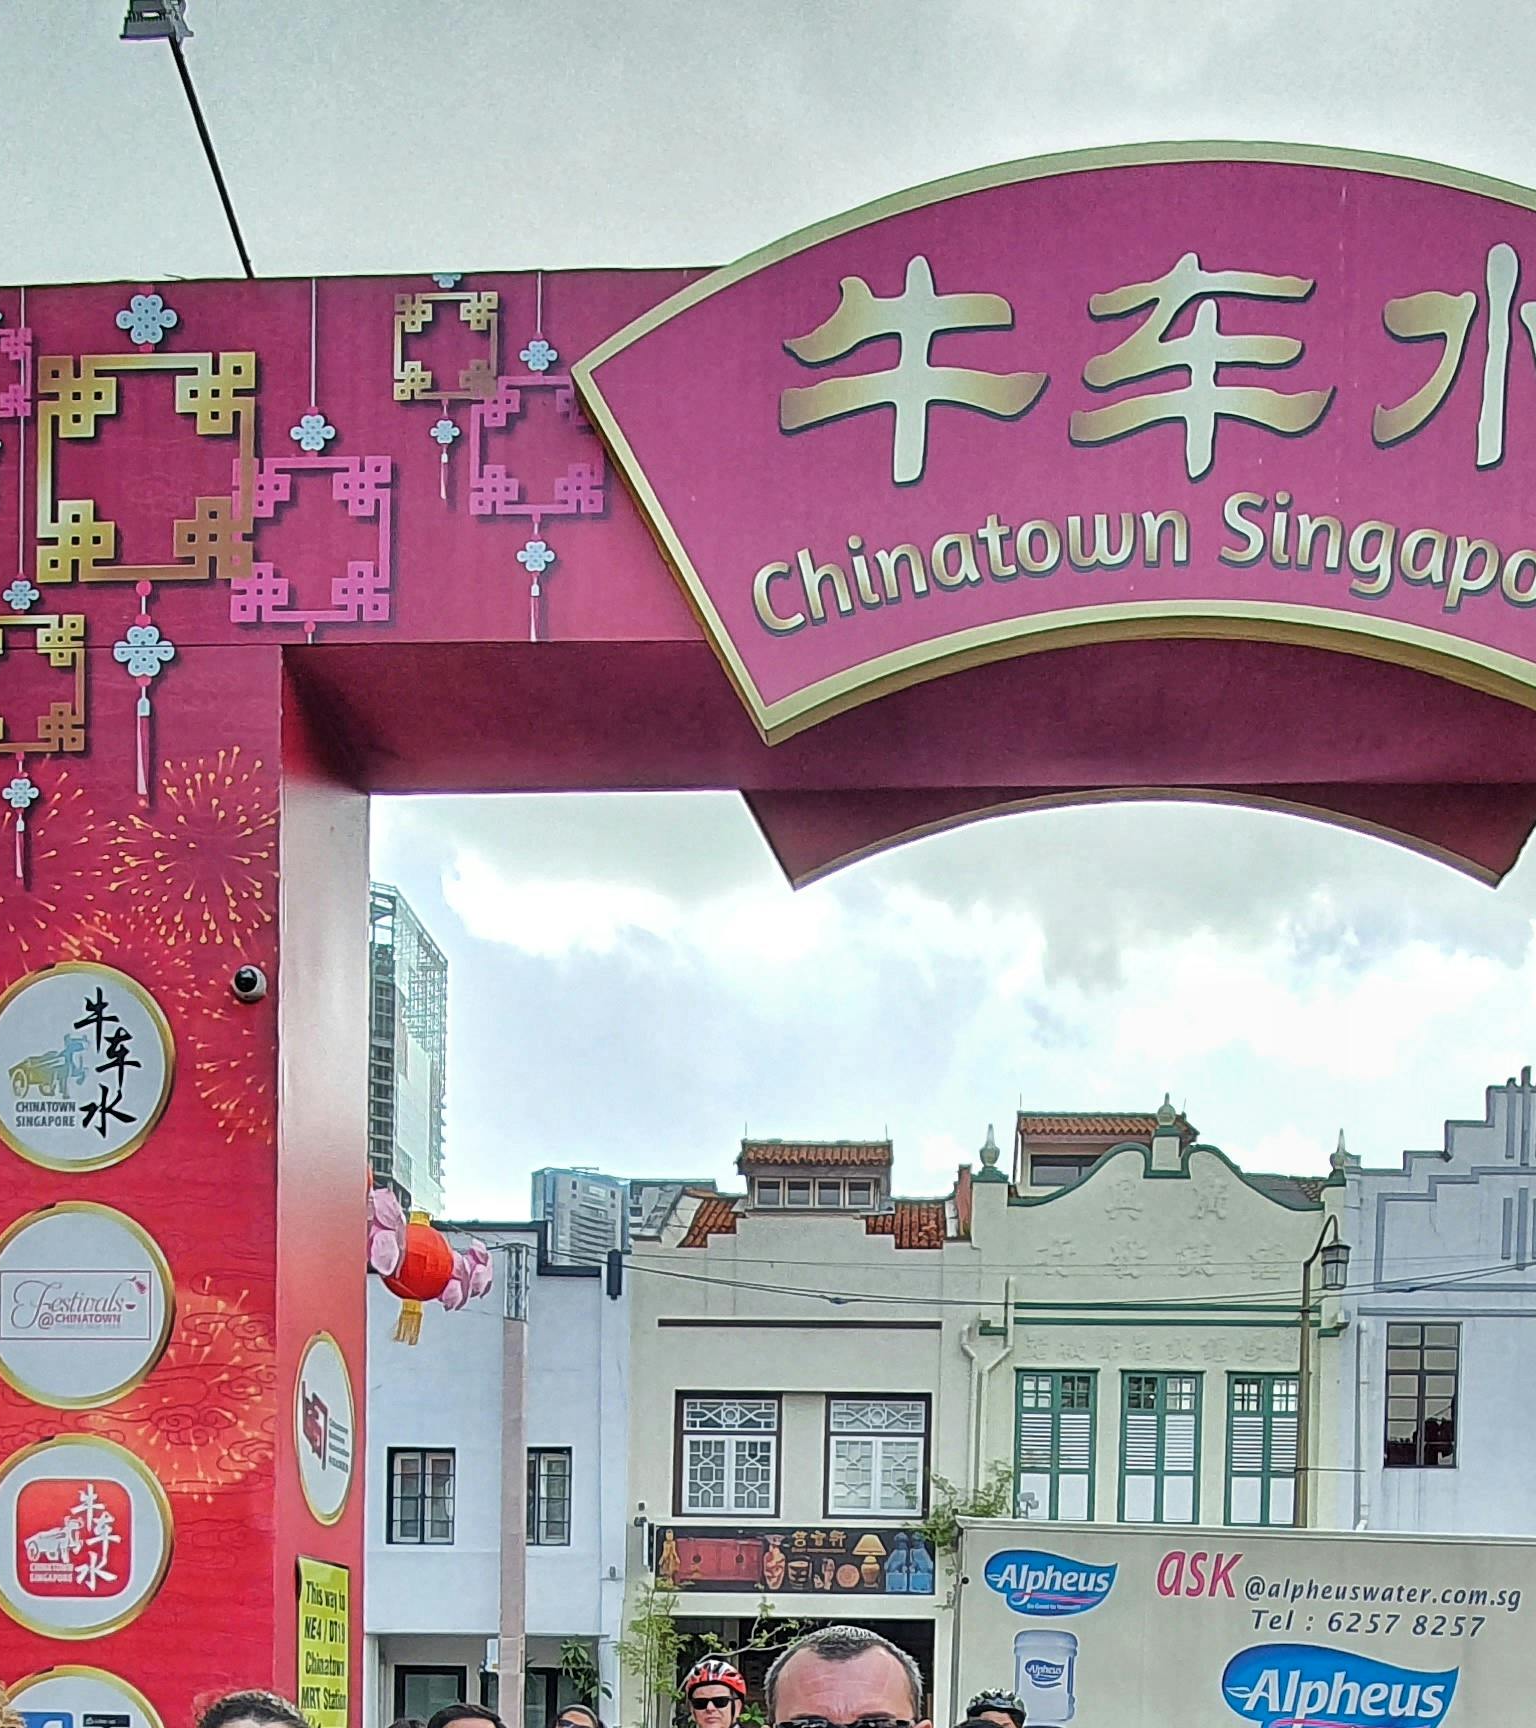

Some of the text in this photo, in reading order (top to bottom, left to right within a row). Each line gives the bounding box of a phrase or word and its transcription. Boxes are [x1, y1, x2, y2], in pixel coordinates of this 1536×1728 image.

[752, 506, 1190, 634] Chinatown
[73, 986, 142, 1139] 牛车水
[15, 1101, 76, 1113] CHINATOWN
[15, 1115, 76, 1128] SINGAPORE
[11, 1279, 125, 1329] Festivals
[38, 1312, 121, 1330] @CHINATOWN
[70, 1483, 122, 1592] 牛车水
[306, 1580, 323, 1605] This
[325, 1589, 338, 1614] way
[987, 1564, 1110, 1605] Alpheus
[1245, 1576, 1522, 1612] @alpheuswater.com.sg
[304, 1616, 322, 1641] NE4
[329, 1618, 346, 1645] DT19
[1250, 1609, 1294, 1631] Tel
[1327, 1612, 1401, 1634] 6257
[1413, 1615, 1486, 1637] 8257
[305, 1651, 345, 1677] Chinatown
[301, 1686, 346, 1711] MRT Station
